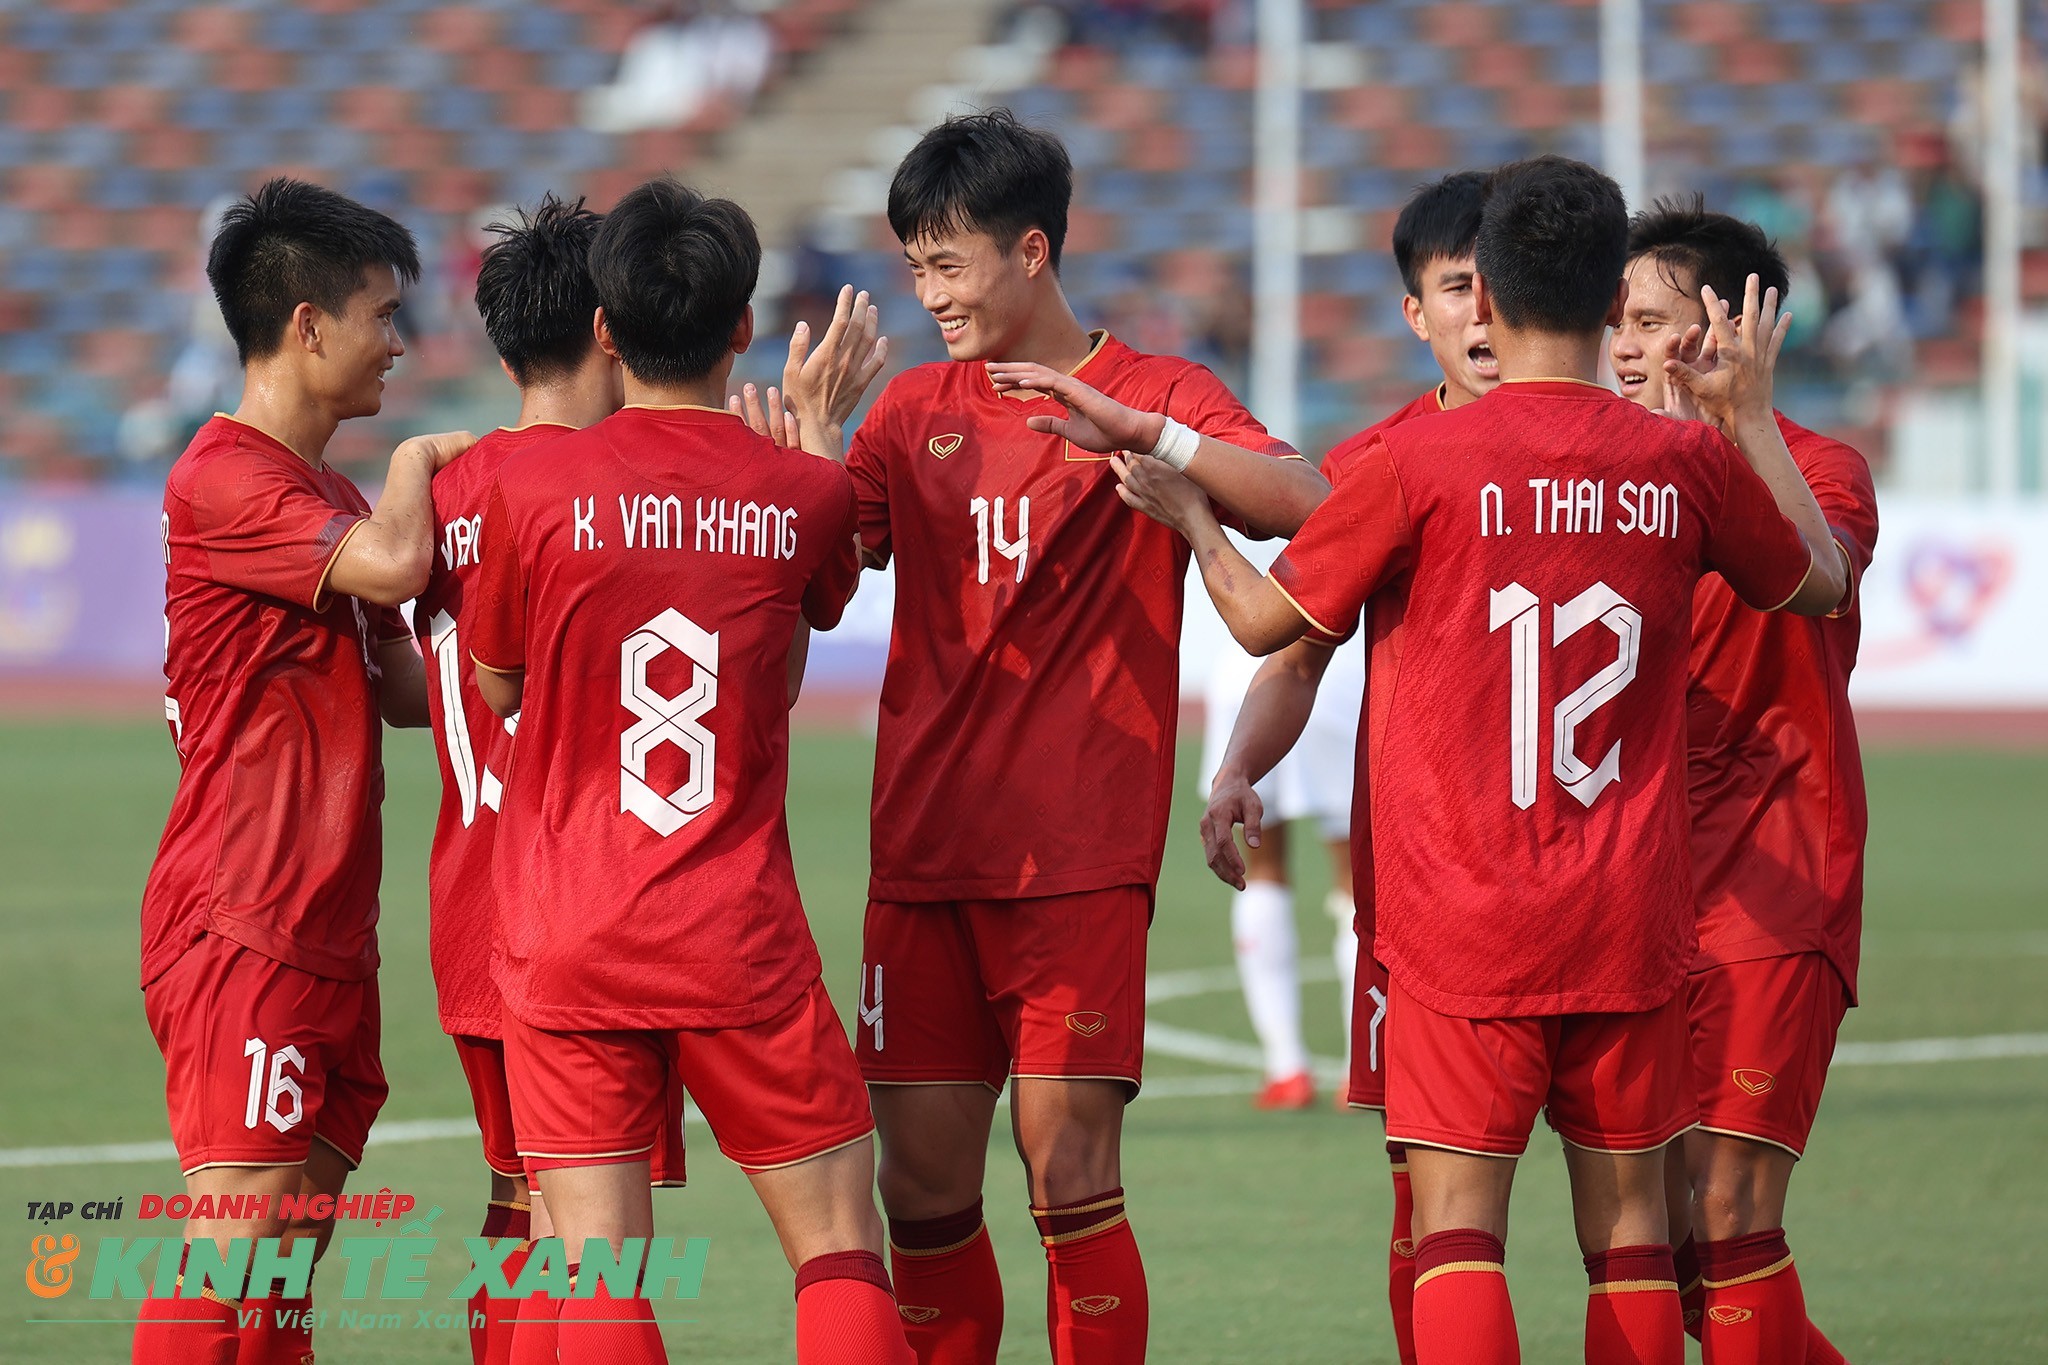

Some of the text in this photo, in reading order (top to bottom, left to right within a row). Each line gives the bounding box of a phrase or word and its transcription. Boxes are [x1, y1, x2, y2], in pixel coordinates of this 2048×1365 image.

[573, 493, 799, 561] K. VAN KHANG
[969, 494, 1030, 585] 14
[1480, 478, 1680, 539] N. THAI SON
[620, 606, 719, 838] 8
[1489, 580, 1643, 811] 12
[243, 1036, 306, 1134] 16
